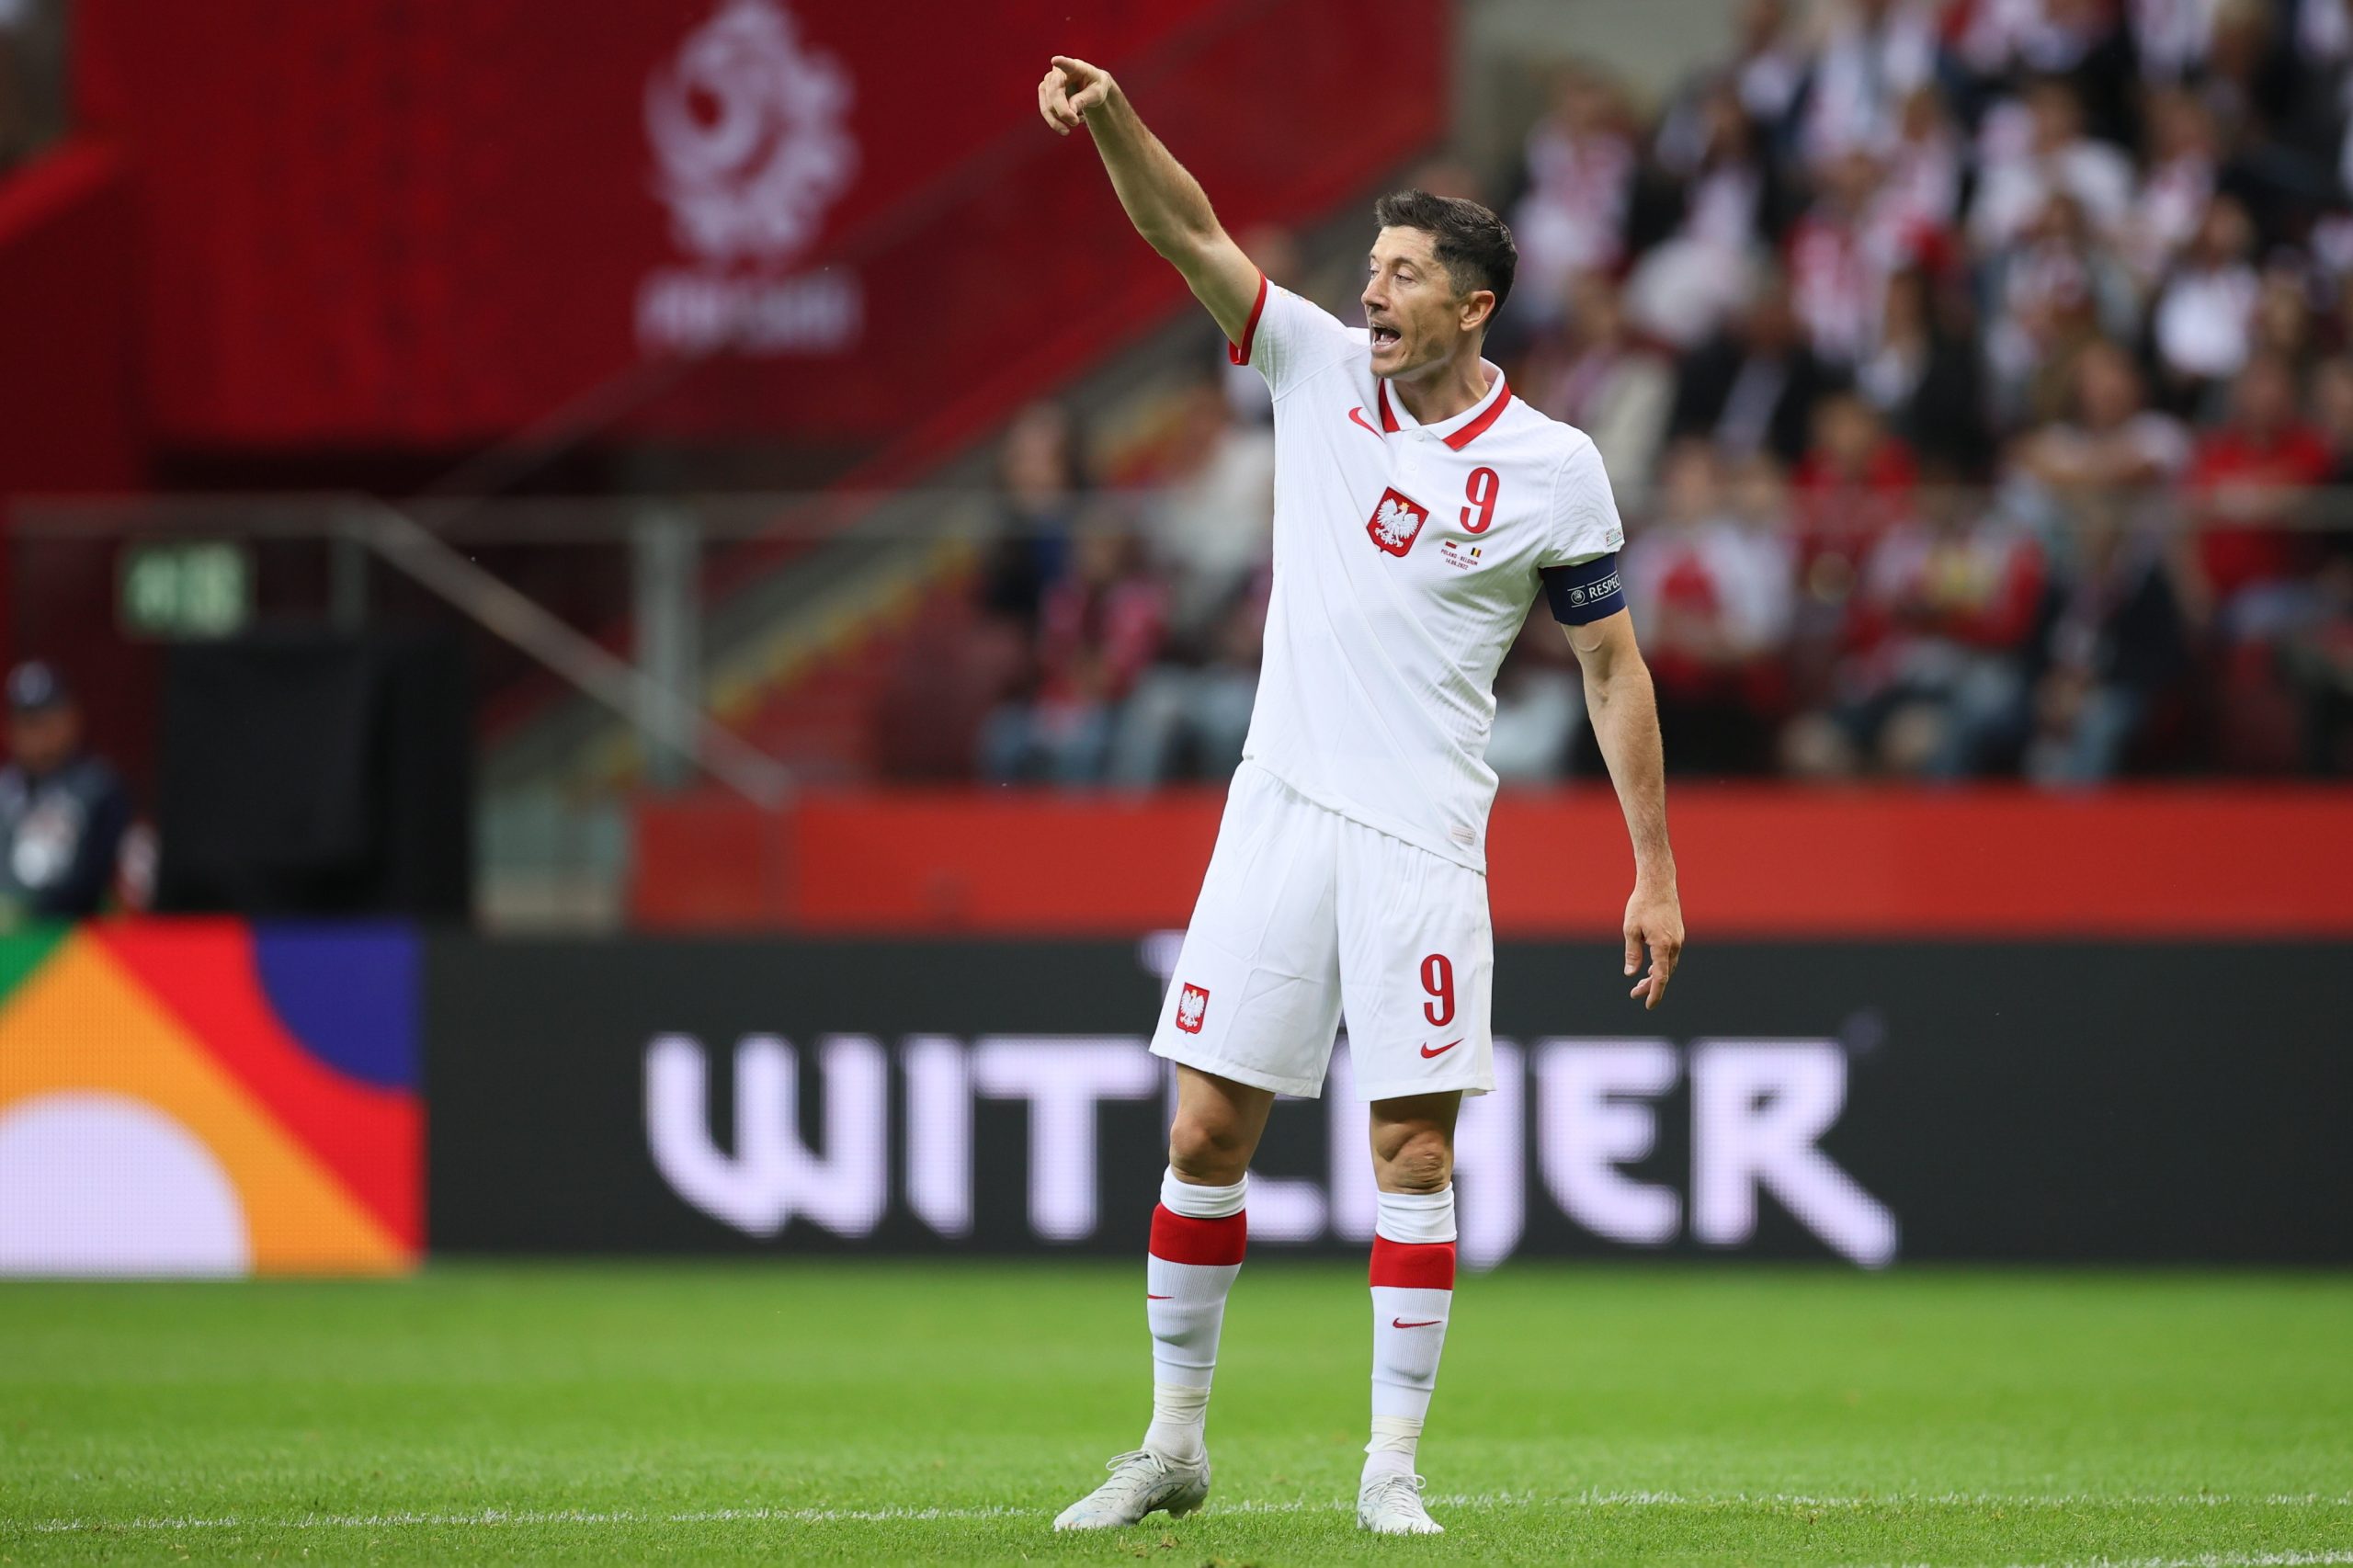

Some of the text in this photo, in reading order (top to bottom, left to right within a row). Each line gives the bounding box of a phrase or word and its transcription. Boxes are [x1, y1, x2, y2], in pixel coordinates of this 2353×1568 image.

[1460, 466, 1500, 534] 9
[1440, 548, 1458, 559] POLAND
[1420, 953, 1455, 1027] 9
